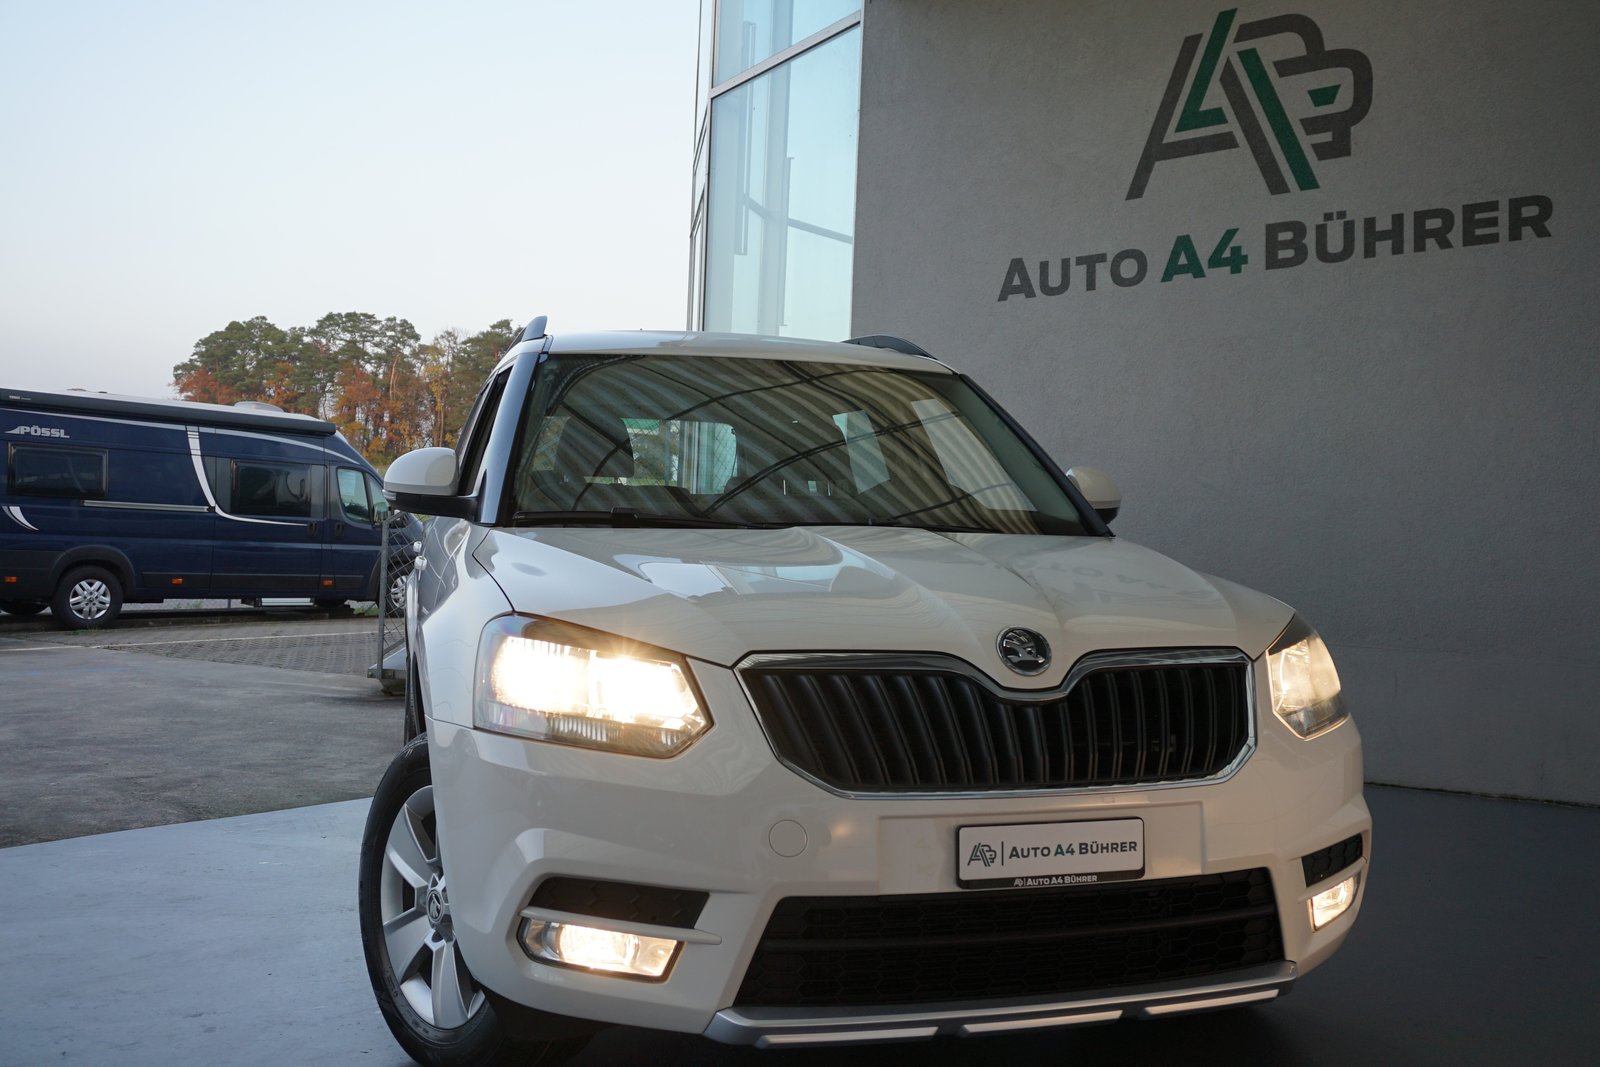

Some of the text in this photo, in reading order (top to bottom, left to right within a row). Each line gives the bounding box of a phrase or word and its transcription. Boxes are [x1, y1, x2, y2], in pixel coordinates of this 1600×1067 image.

[997, 195, 1554, 302] AUTO A4 BÜHRER
[19, 424, 71, 439] PÖSSL
[1008, 846, 1051, 860] AUTO
[1053, 843, 1076, 857] A4
[1078, 840, 1138, 855] BÜHRER
[1026, 877, 1050, 887] AUTO
[1050, 876, 1064, 885] A4
[1064, 874, 1098, 884] BÜHRER
